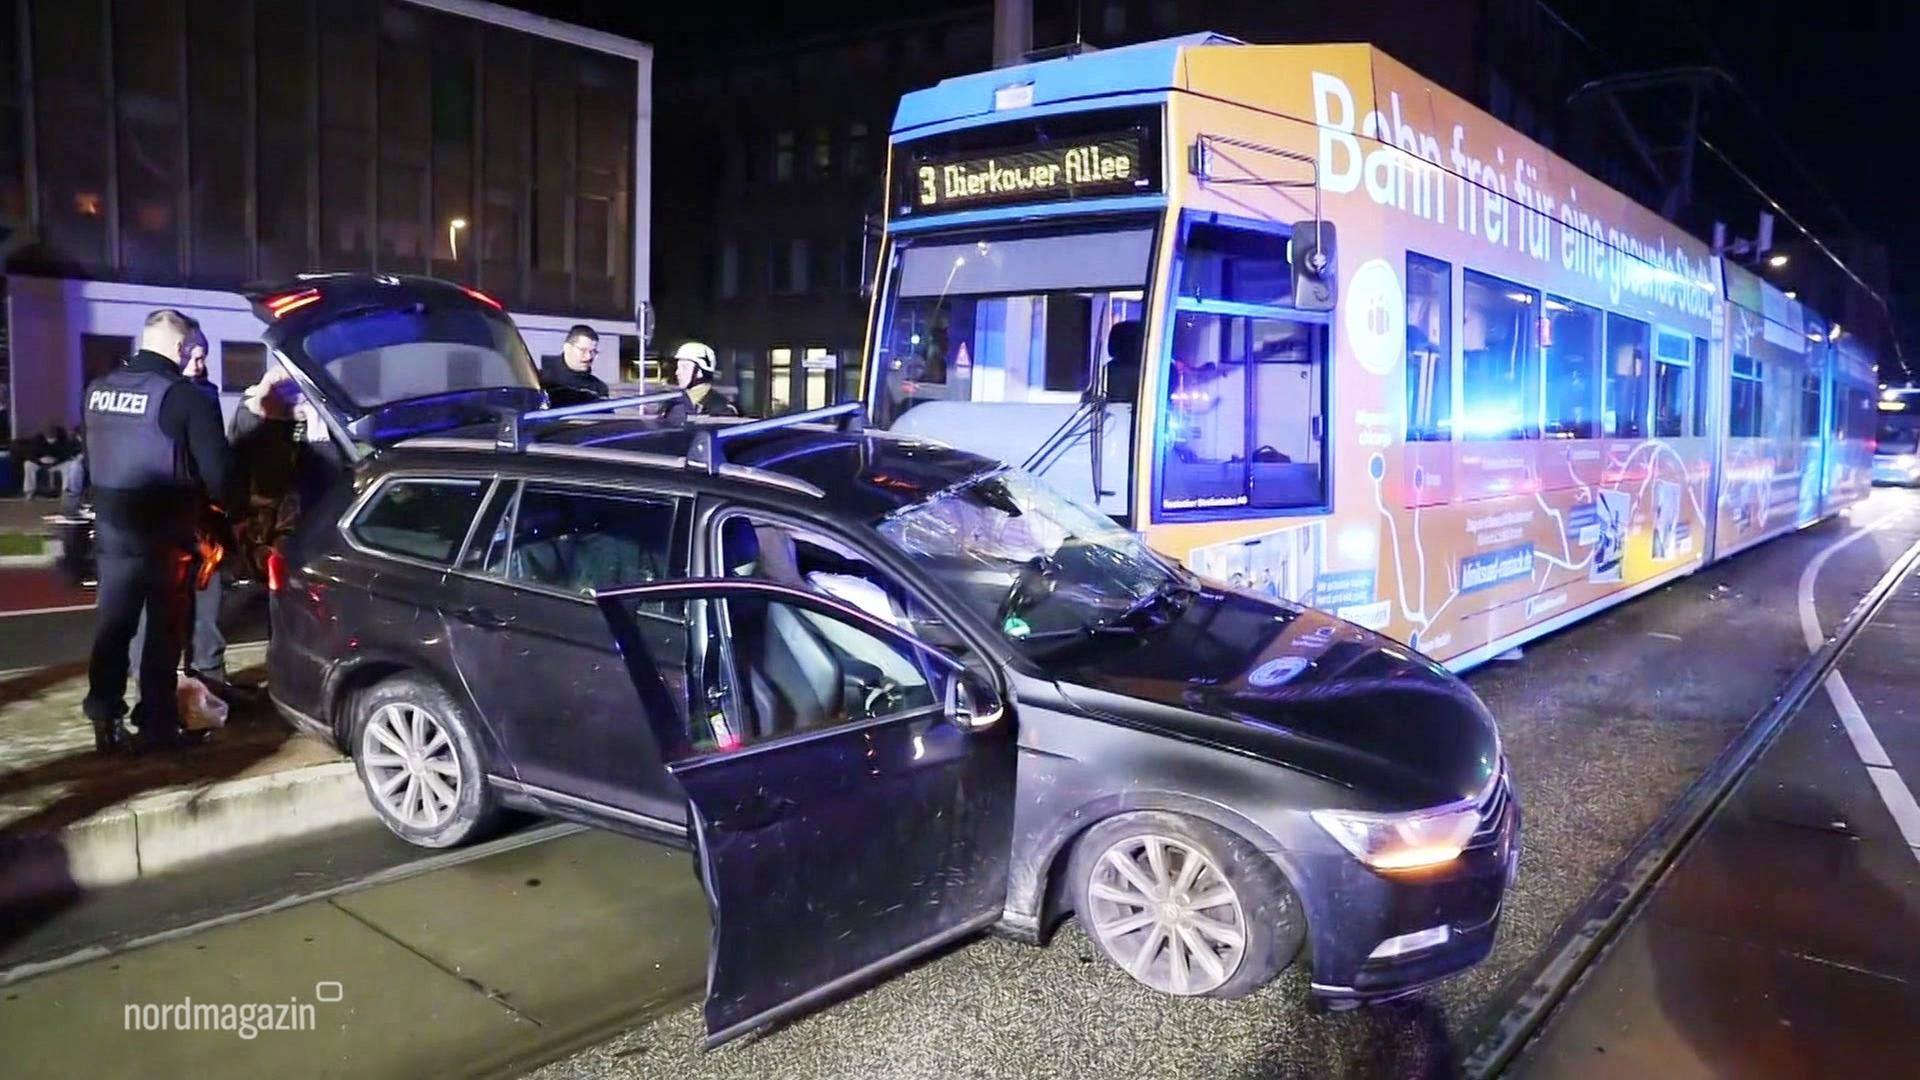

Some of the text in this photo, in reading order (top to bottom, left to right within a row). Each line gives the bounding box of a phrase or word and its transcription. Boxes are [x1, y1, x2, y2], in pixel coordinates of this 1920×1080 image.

[919, 146, 1131, 206] 3 Dierkower Allee
[1312, 71, 1445, 224] Bahn
[1452, 124, 1509, 248] frei
[1514, 158, 1554, 262] für
[1560, 187, 1605, 282] eine
[89, 390, 149, 415] POLIZEI
